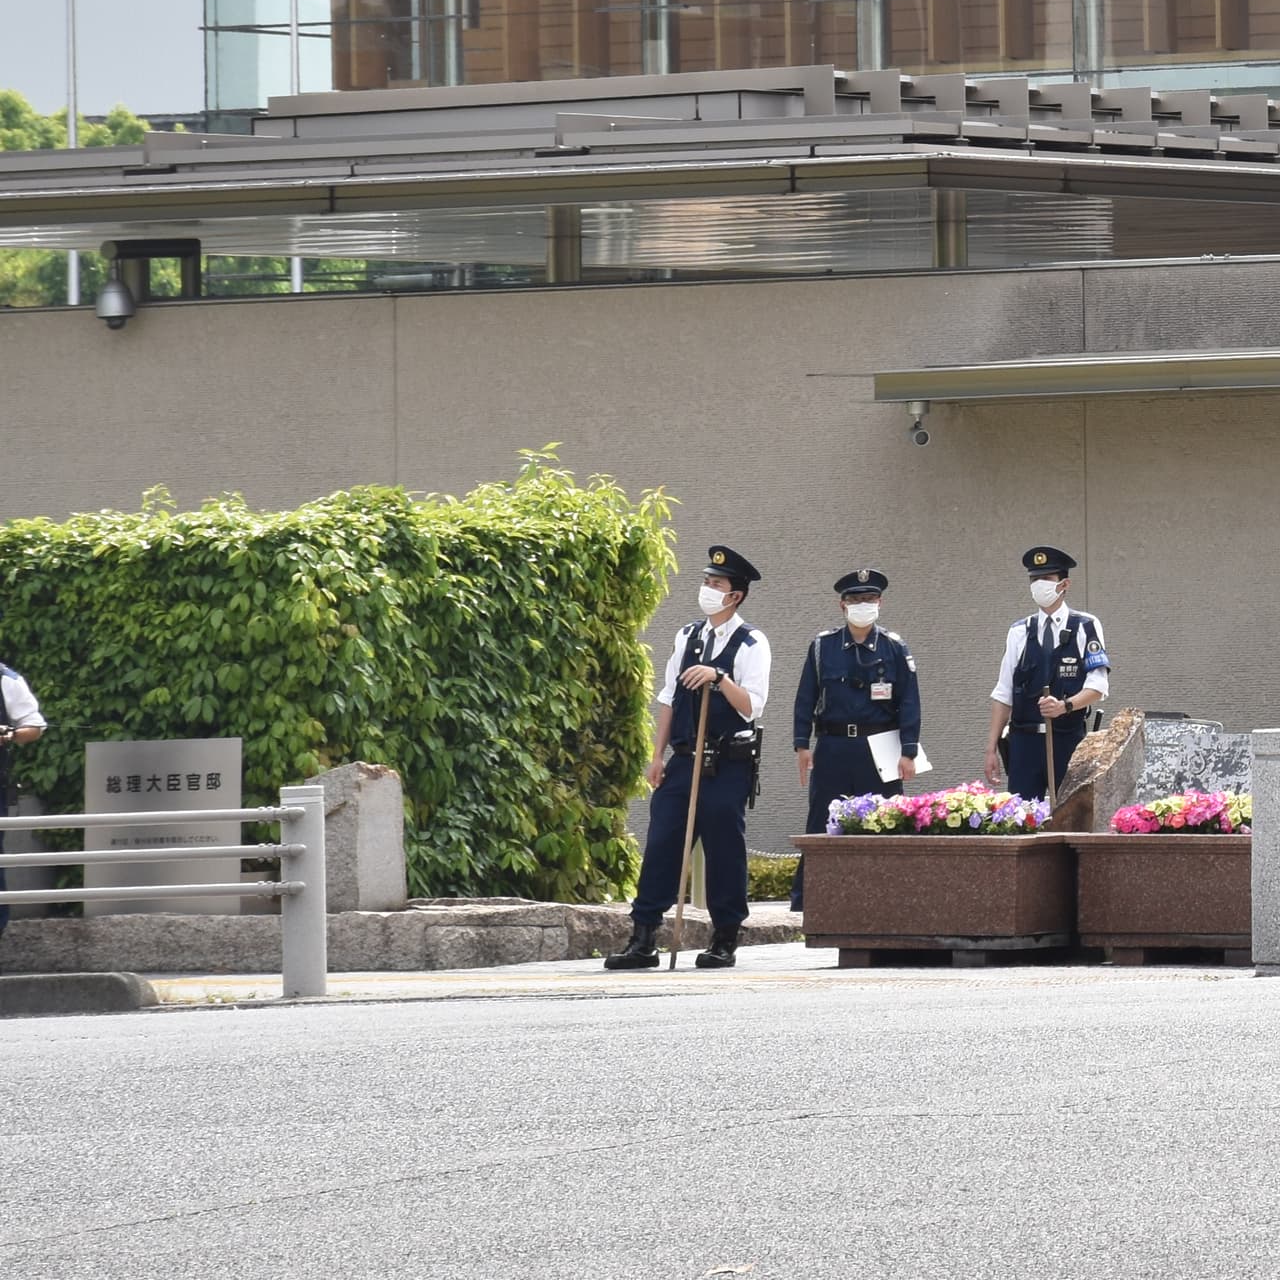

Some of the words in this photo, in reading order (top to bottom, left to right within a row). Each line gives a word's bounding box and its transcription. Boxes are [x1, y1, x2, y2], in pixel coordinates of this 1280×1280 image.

[105, 773, 221, 794] 総理大臣官邸
